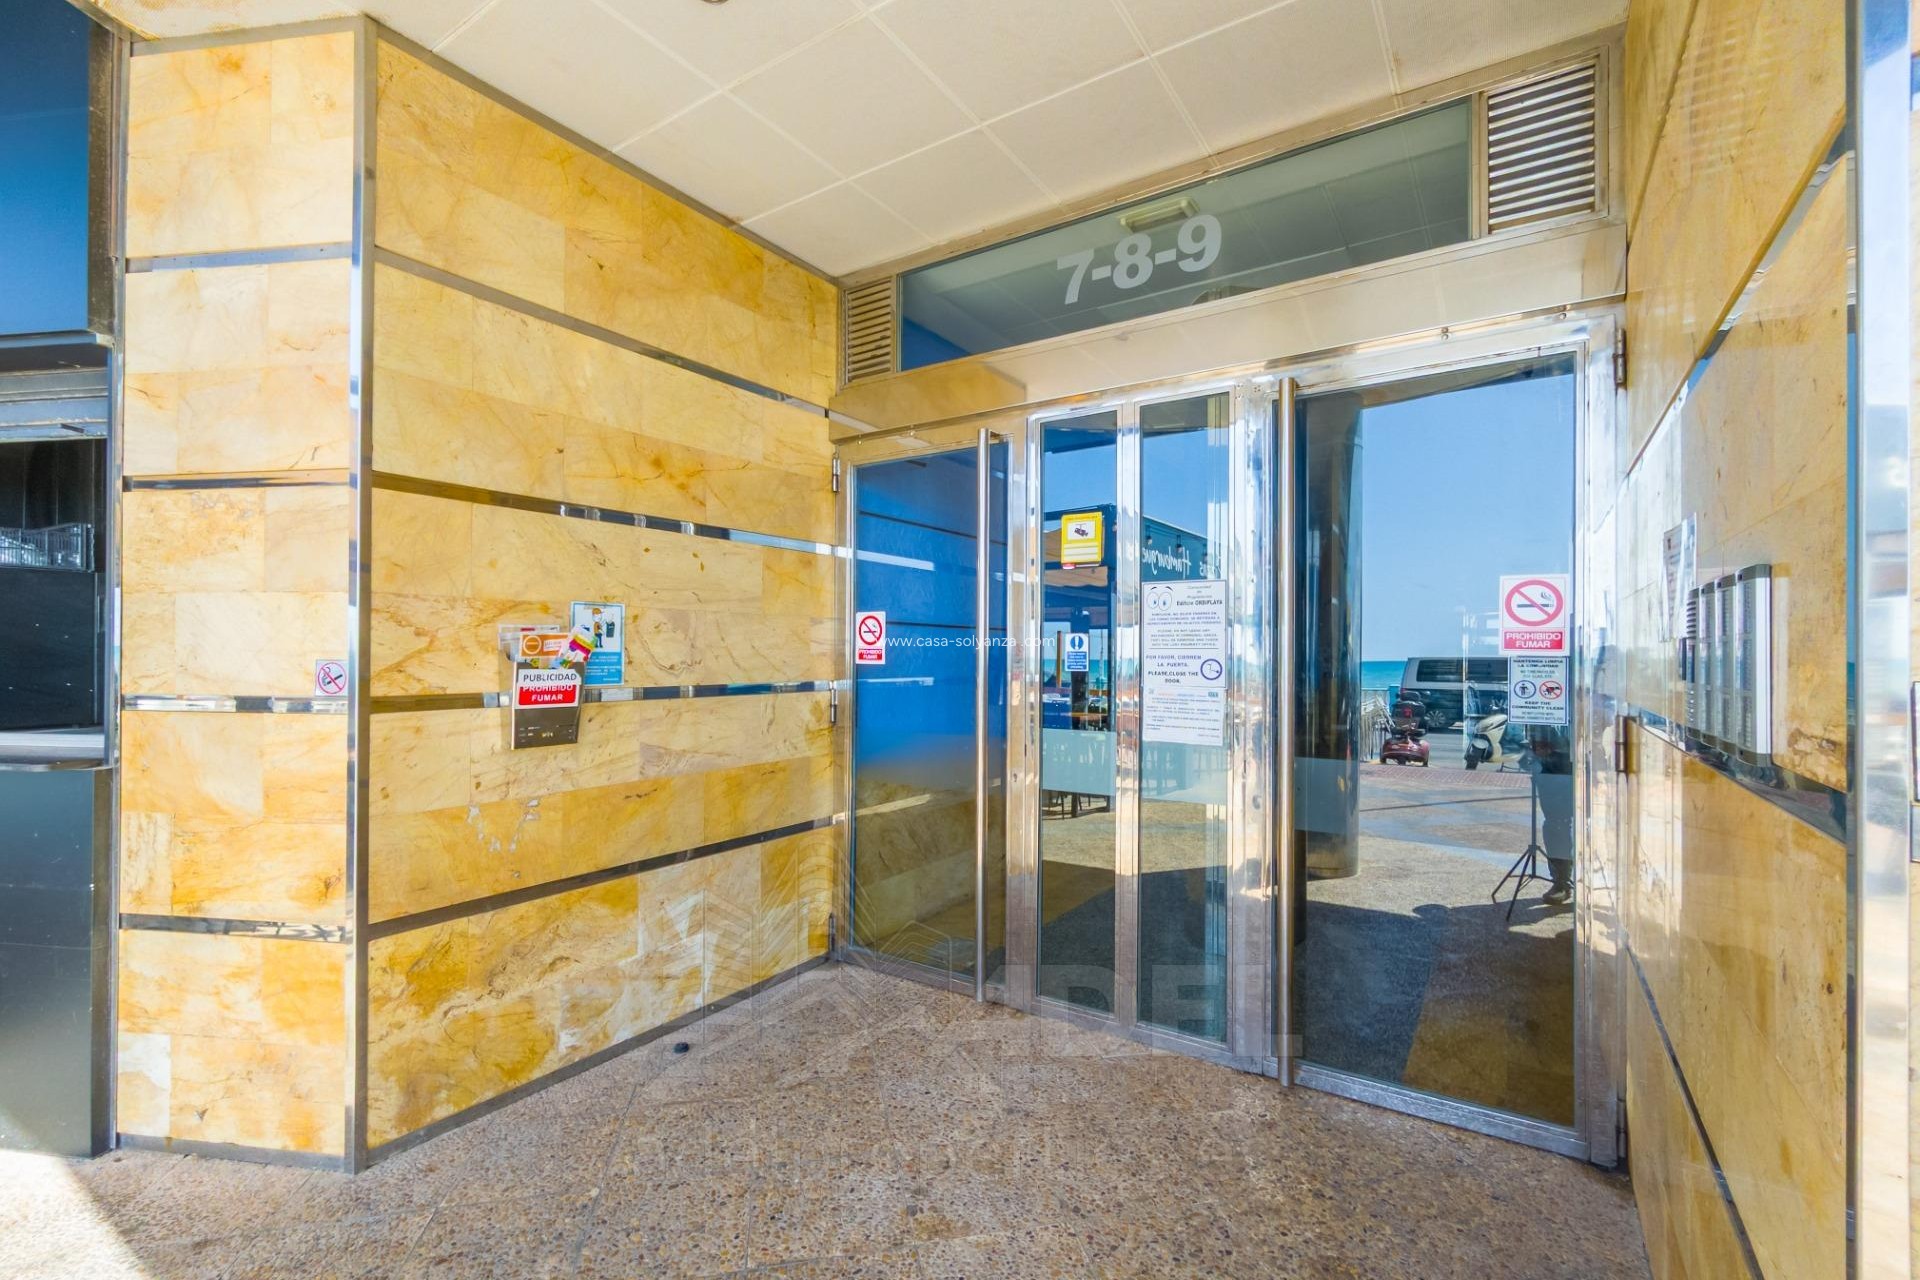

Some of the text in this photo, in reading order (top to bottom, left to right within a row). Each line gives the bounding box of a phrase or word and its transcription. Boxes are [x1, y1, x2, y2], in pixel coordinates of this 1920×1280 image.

[1056, 214, 1222, 305] 7-8-9
[1505, 632, 1561, 640] PROHIBIDO
[1515, 640, 1551, 648] FUMAR
[523, 673, 577, 682] PUBLICIDAD
[531, 694, 564, 702] FUMAR
